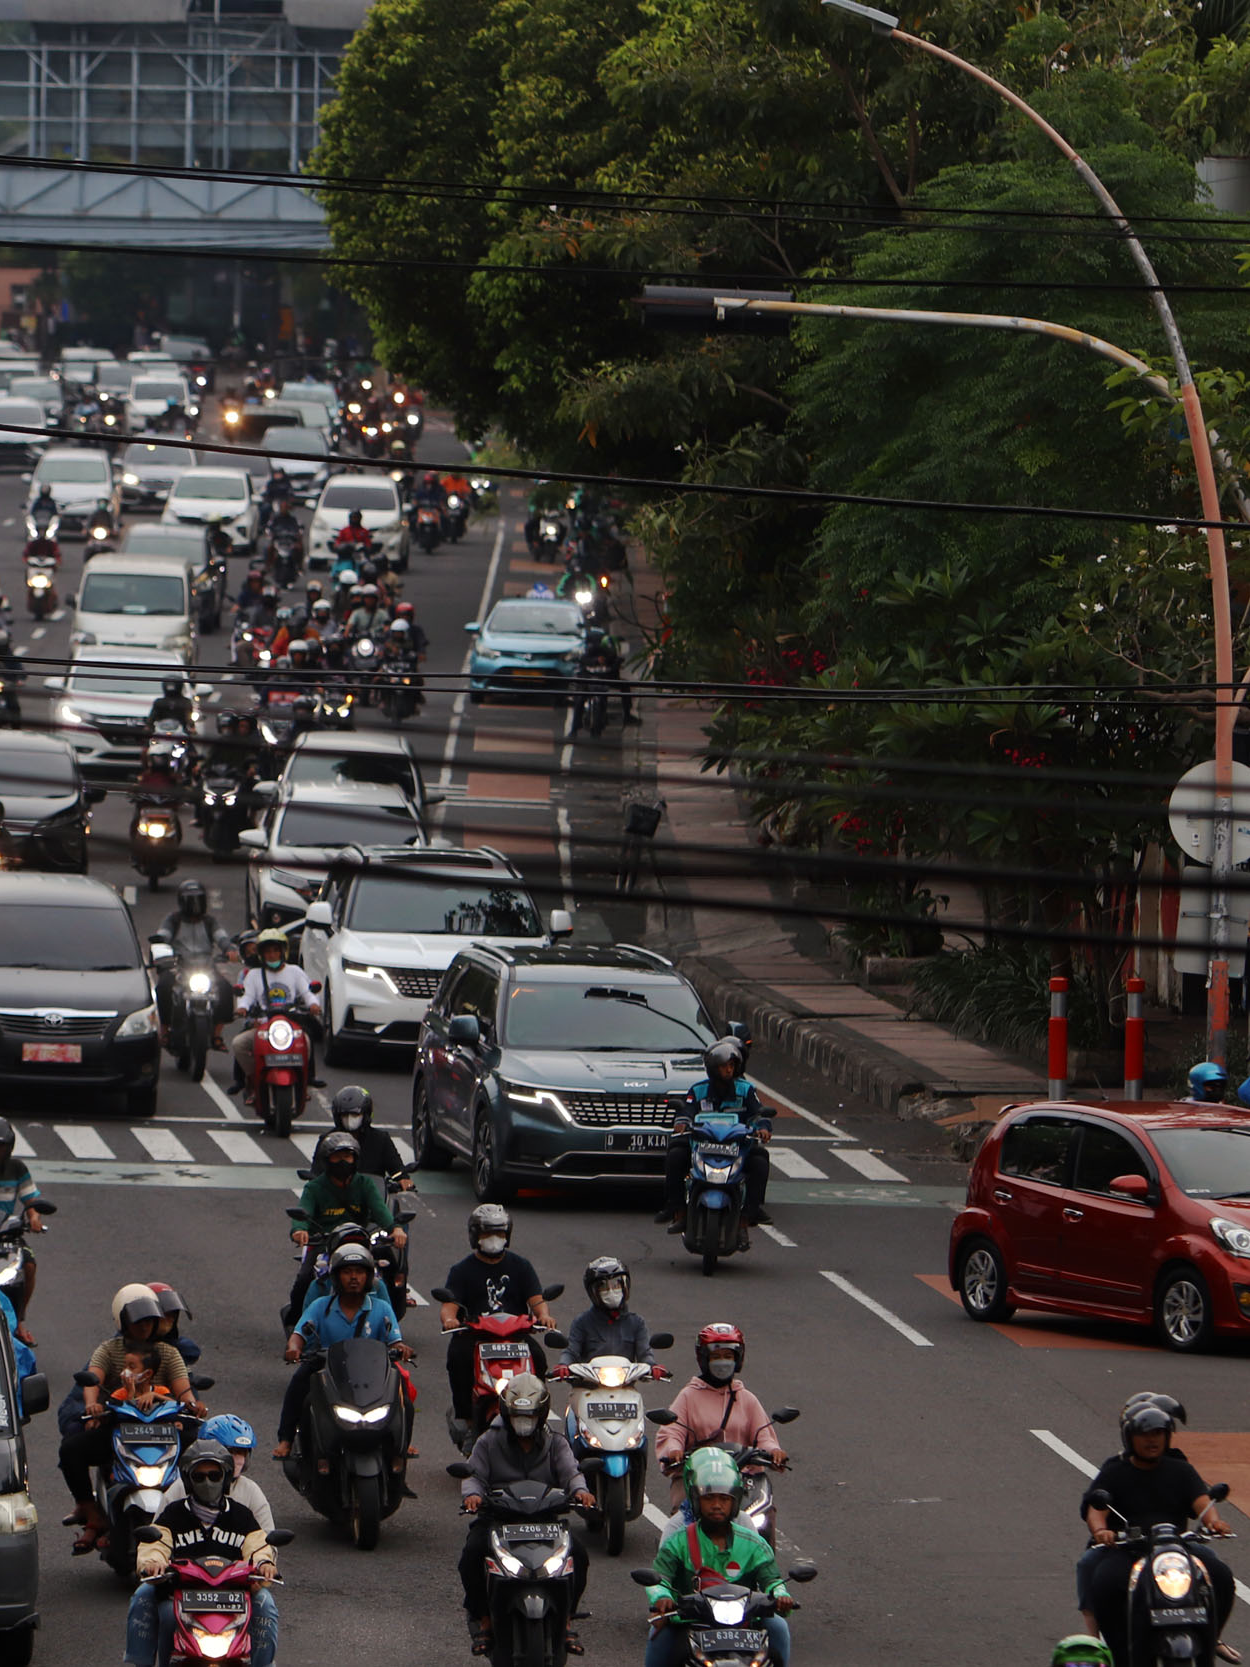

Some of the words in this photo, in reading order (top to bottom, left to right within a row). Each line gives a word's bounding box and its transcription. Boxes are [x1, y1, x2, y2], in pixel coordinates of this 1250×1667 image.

[607, 1134, 614, 1146] D
[647, 1135, 666, 1147] KIA
[196, 1593, 219, 1602] 3352
